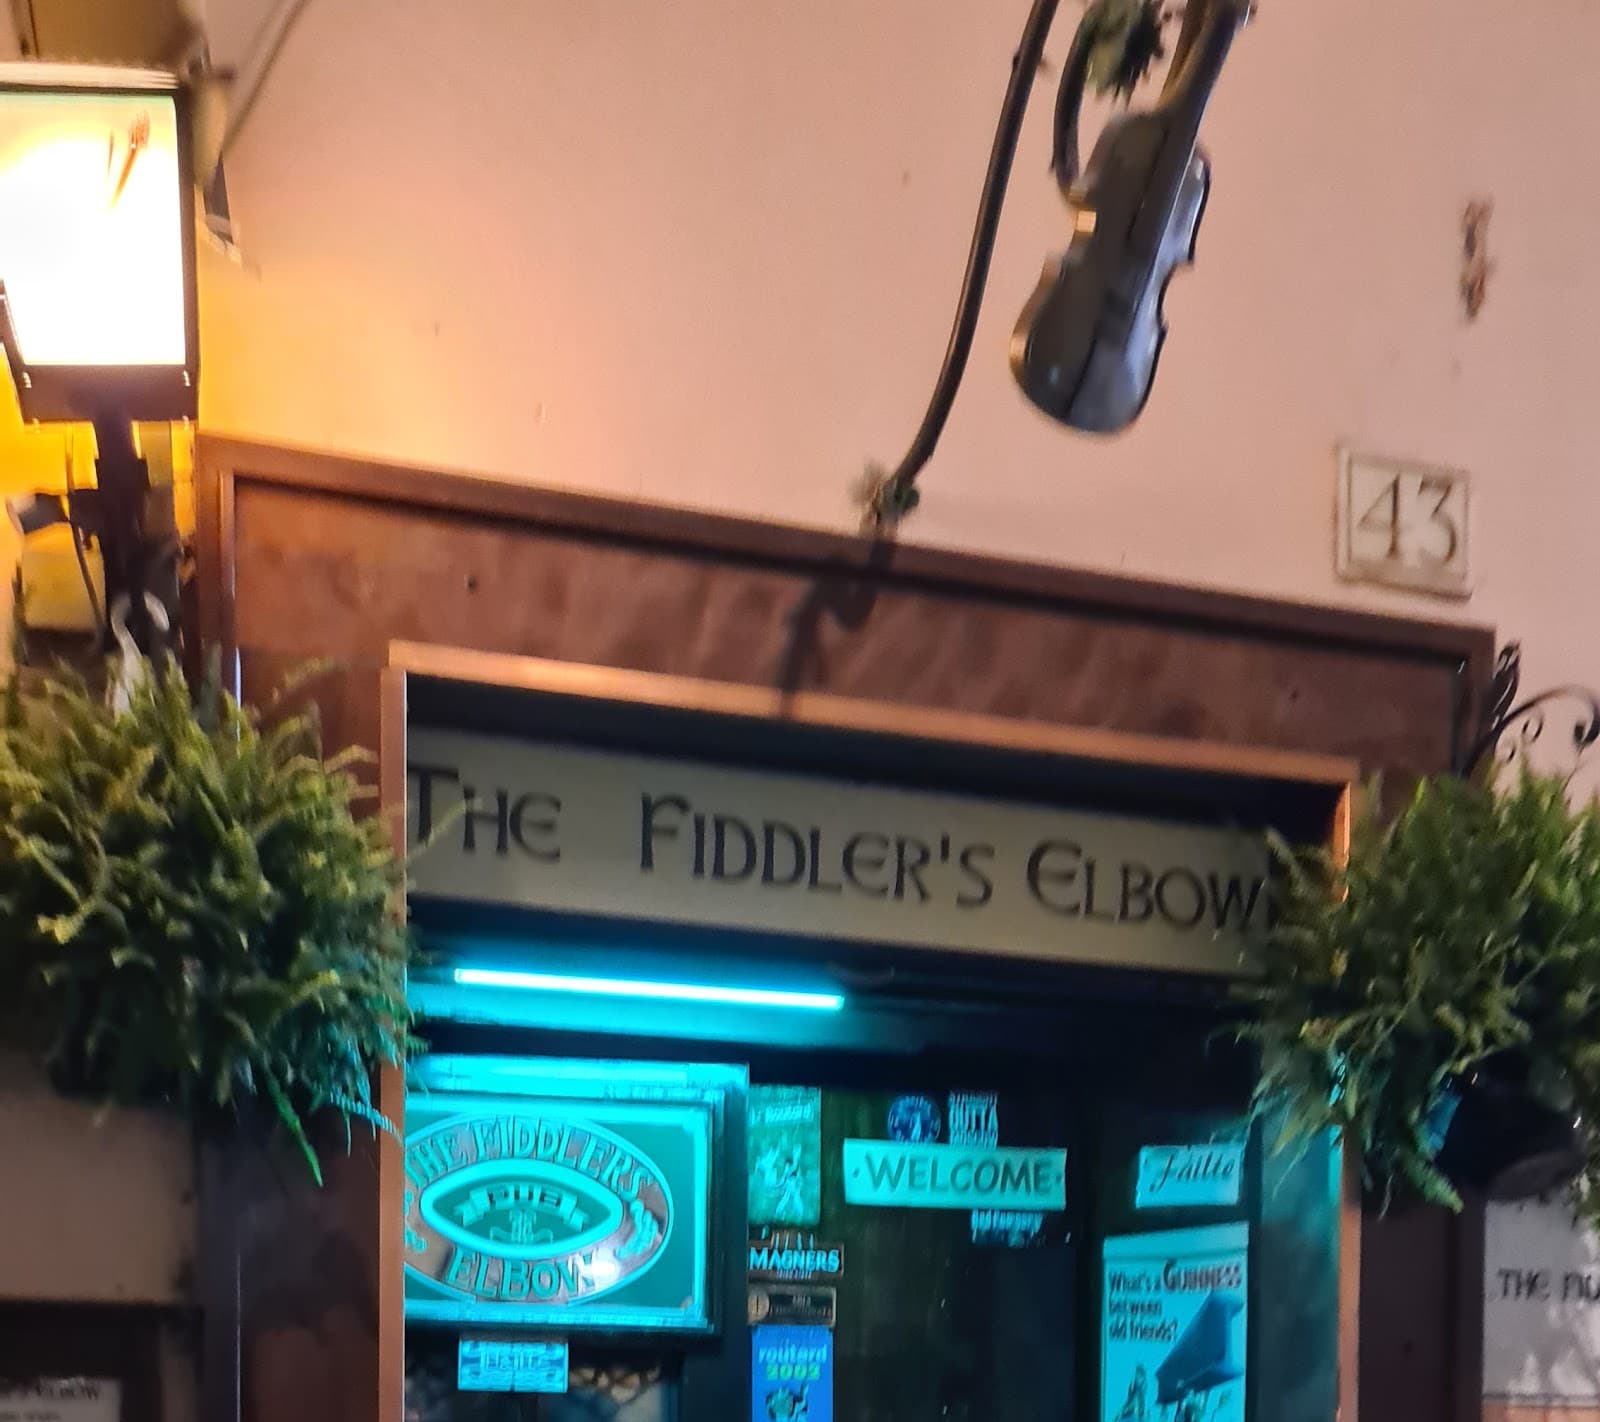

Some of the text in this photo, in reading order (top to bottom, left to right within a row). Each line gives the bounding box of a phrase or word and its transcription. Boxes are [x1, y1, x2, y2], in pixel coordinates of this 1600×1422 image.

[1356, 472, 1458, 568] 43
[406, 765, 1268, 935] THE FIDDLER'S ELBOW
[405, 1131, 467, 1189] THE
[864, 1151, 1054, 1194] WELCOME
[749, 1246, 841, 1273] MAGNERS
